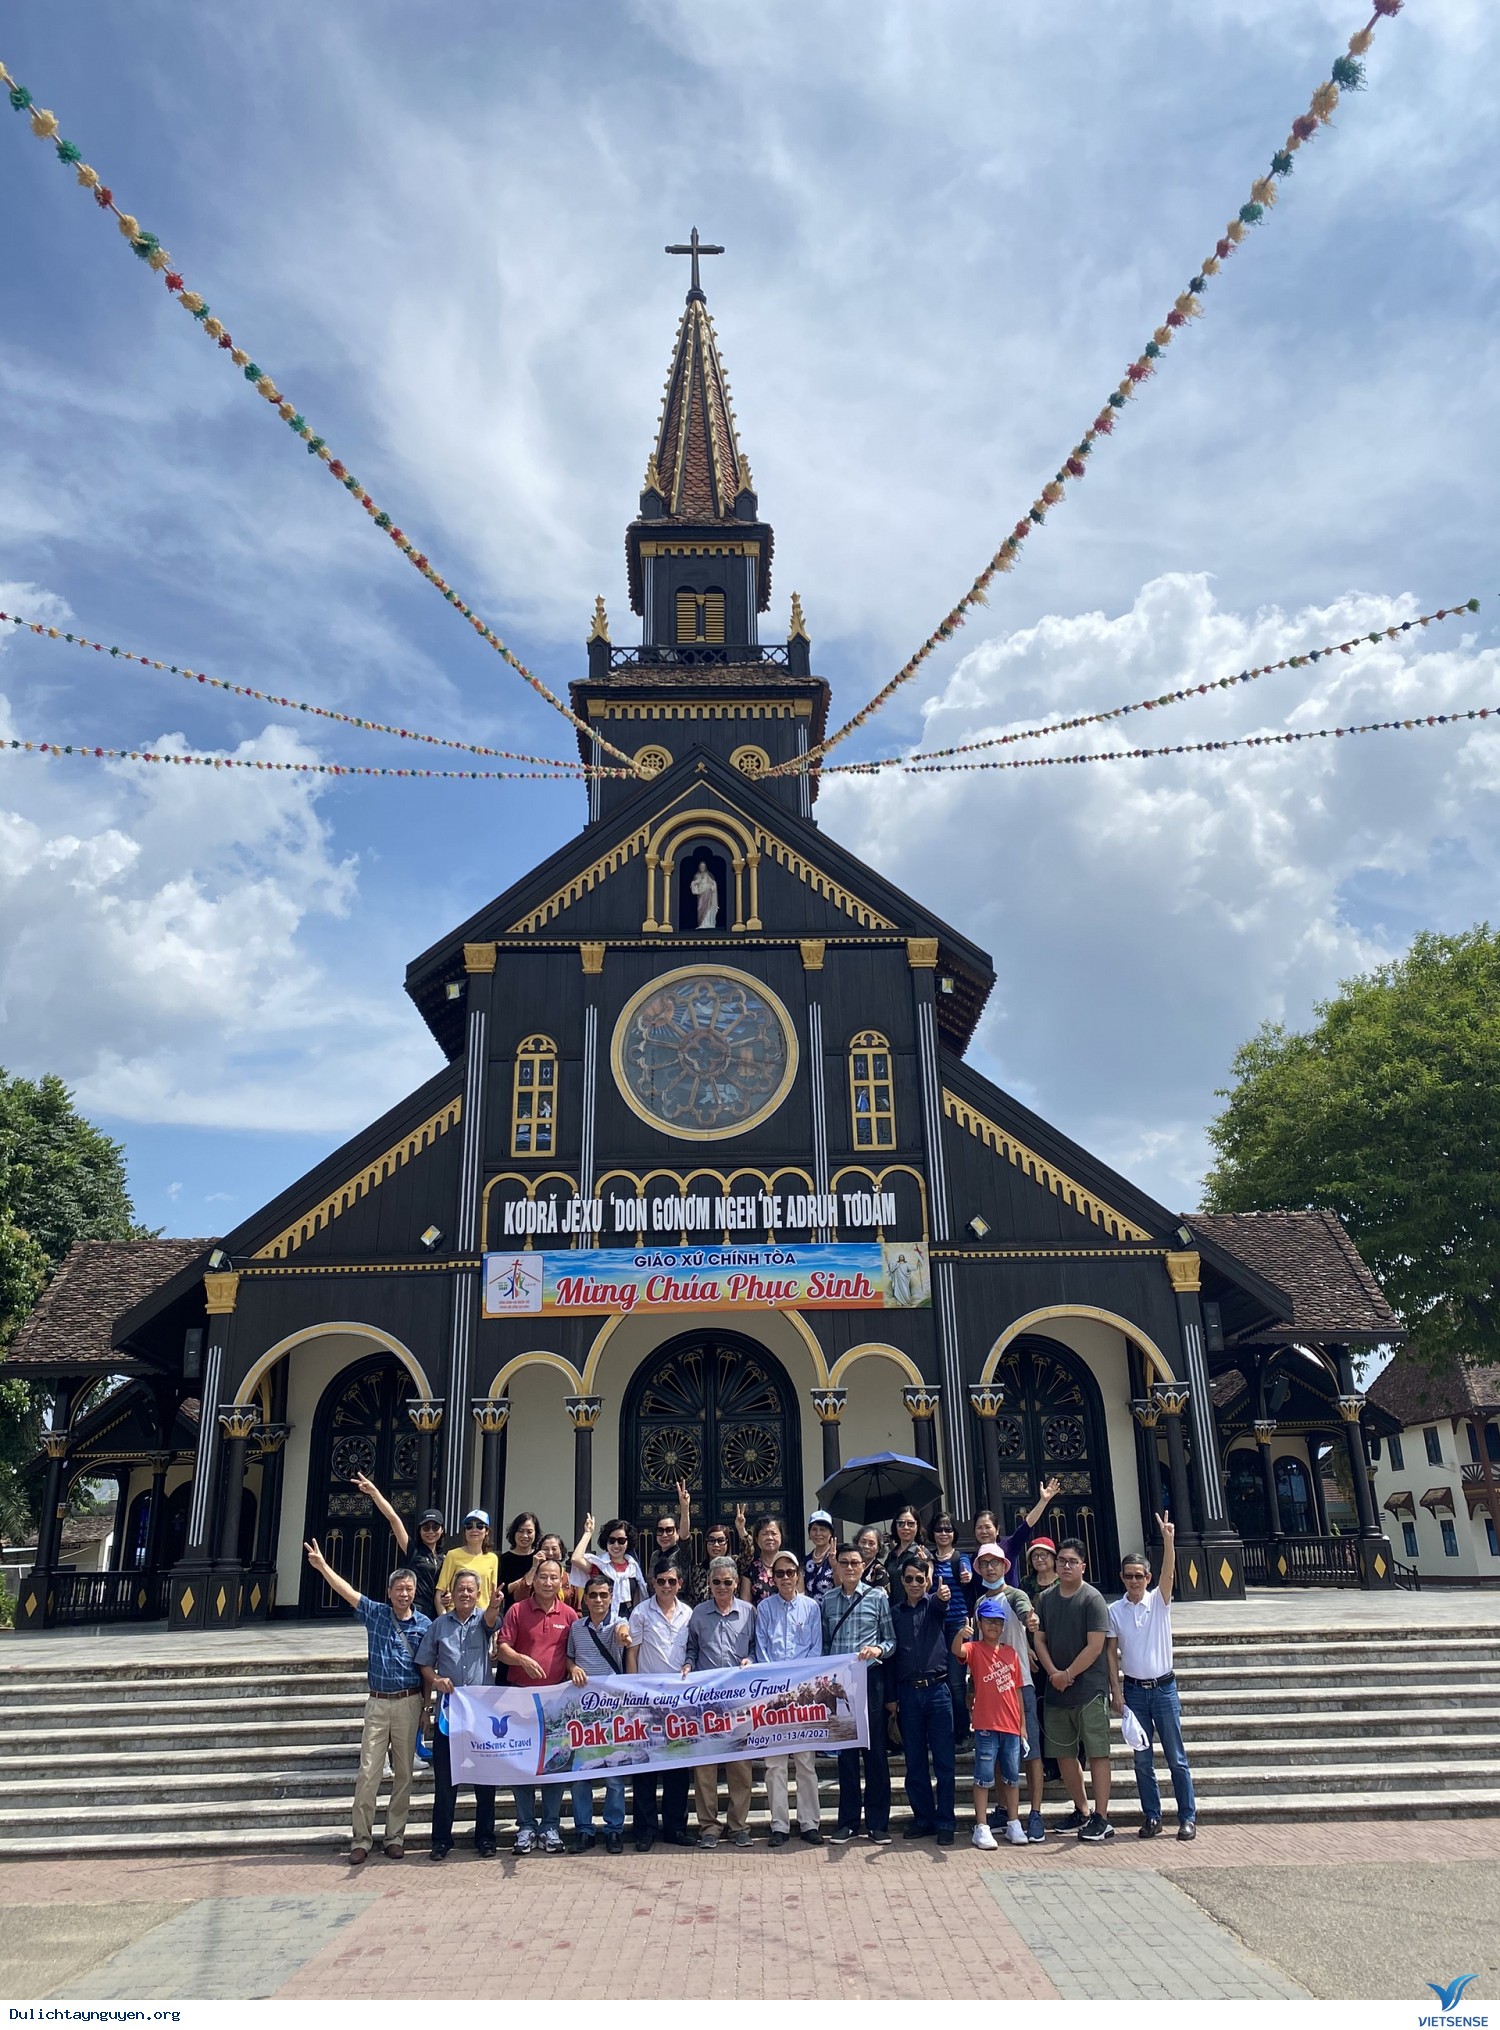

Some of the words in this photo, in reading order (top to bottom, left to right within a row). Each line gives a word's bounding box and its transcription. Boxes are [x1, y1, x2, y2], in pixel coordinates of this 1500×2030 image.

[715, 1196, 757, 1230] NGEH
[786, 1194, 839, 1228] ADRUH
[634, 1252, 676, 1267] GIÁO
[681, 1251, 704, 1267] XỨ
[708, 1251, 759, 1265] CHÍNH
[764, 1249, 796, 1264] TÒA
[556, 1276, 639, 1311] Mừng
[646, 1274, 721, 1302] Chúa
[727, 1274, 799, 1306] Phục
[806, 1271, 874, 1299] Sinh
[581, 1691, 620, 1711] Đồng
[623, 1691, 650, 1706] hành
[653, 1692, 680, 1707] cùng
[683, 1685, 746, 1705] Vietsense
[749, 1678, 790, 1698] Travel
[567, 1720, 609, 1748] Dak
[666, 1714, 699, 1740] Gia
[751, 1702, 827, 1731] Kontum
[748, 1734, 770, 1746] Ngày
[772, 1733, 782, 1742] 10
